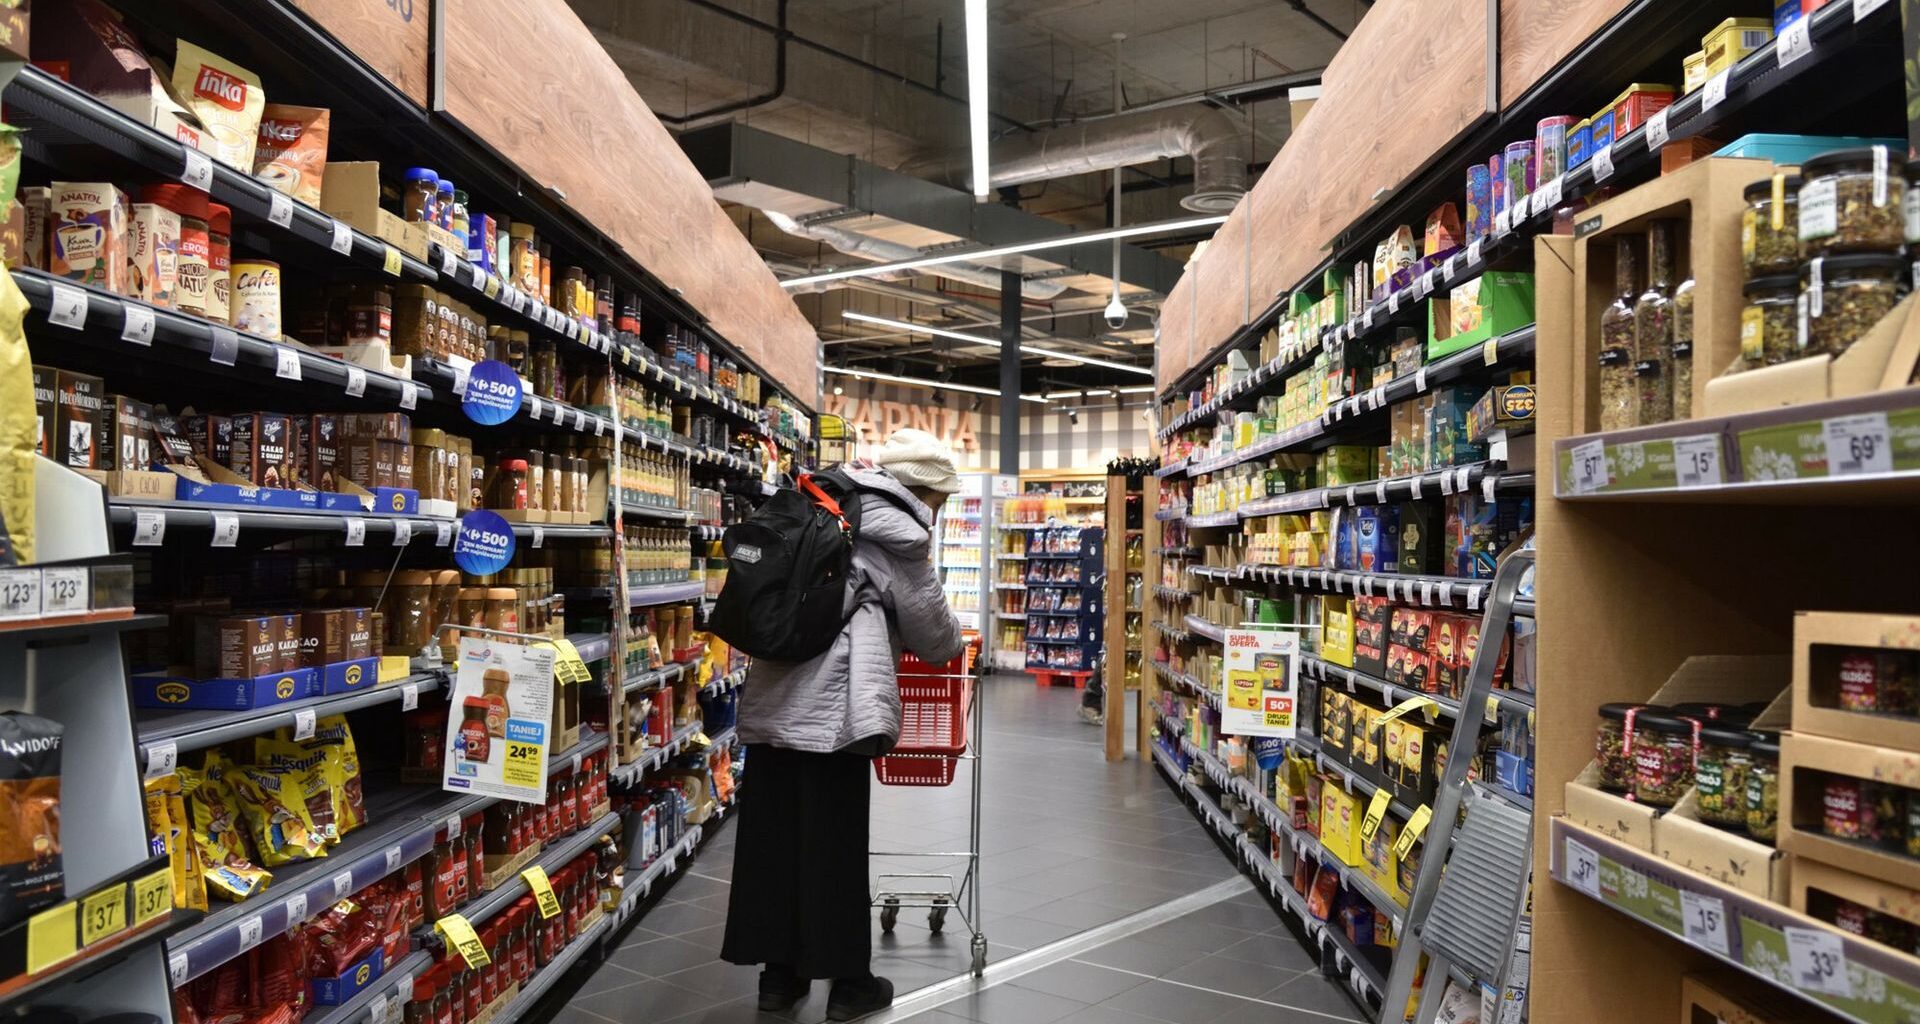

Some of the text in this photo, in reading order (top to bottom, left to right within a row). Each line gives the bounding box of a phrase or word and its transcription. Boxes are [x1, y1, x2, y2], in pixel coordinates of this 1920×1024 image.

[200, 70, 242, 103] inka
[259, 120, 302, 142] nka
[60, 192, 102, 205] ANATOL
[135, 220, 147, 257] ANATOL
[489, 381, 517, 398] 500
[260, 445, 284, 454] KAKAO
[1850, 435, 1875, 461] 69
[397, 464, 412, 473] KAKAO
[1584, 456, 1597, 476] 67
[1691, 453, 1709, 473] 15
[481, 533, 509, 547] 500
[3, 583, 30, 604] 123
[51, 580, 76, 599] 123
[278, 639, 299, 650] KAKAO
[350, 631, 369, 642] KAKAO
[253, 643, 273, 655] KAKAO
[509, 724, 542, 735] TANIEJ
[270, 751, 327, 774] Nesquik
[510, 746, 538, 759] 24 99
[1578, 857, 1591, 880] 37
[146, 886, 164, 912] 37
[96, 902, 116, 930] 37
[1698, 909, 1716, 933] 15
[1810, 951, 1834, 977] 33
